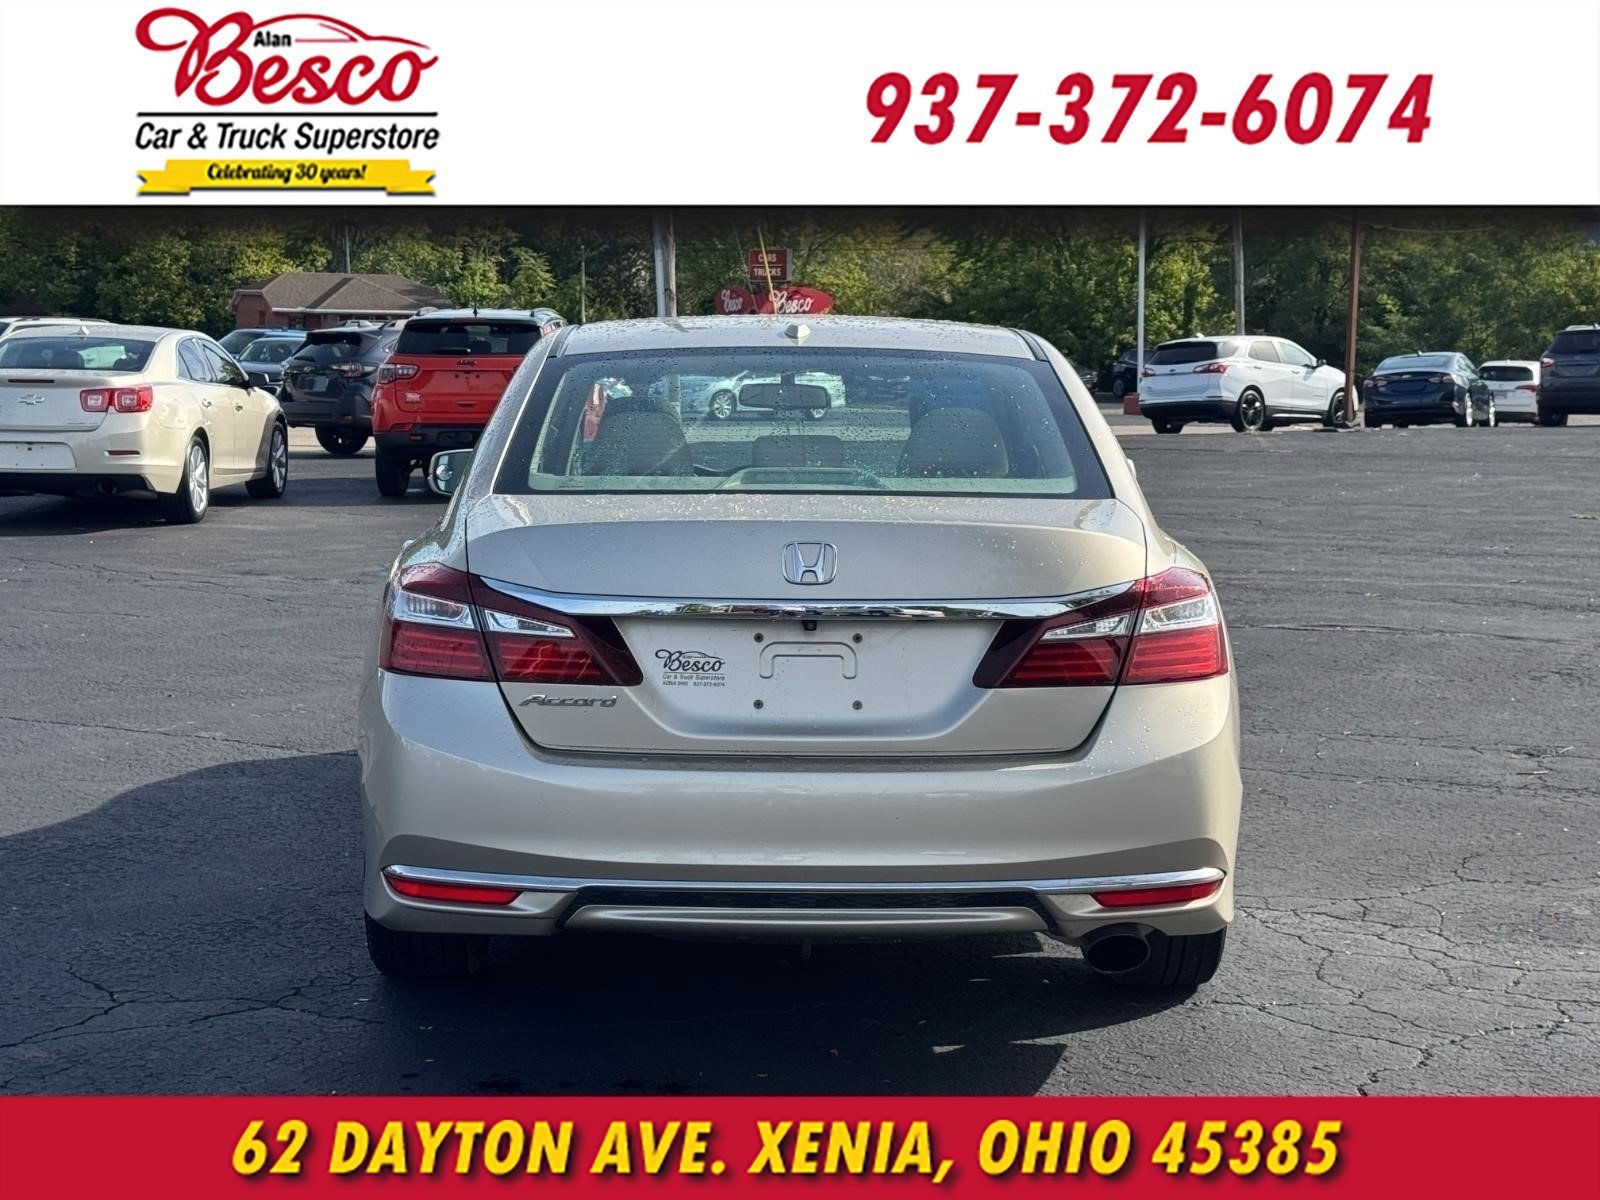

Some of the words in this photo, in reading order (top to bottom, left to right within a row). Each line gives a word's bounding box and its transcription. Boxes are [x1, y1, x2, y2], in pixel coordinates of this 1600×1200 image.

[769, 290, 815, 313] Besco
[655, 649, 726, 672] Besco
[518, 694, 618, 707] Accord
